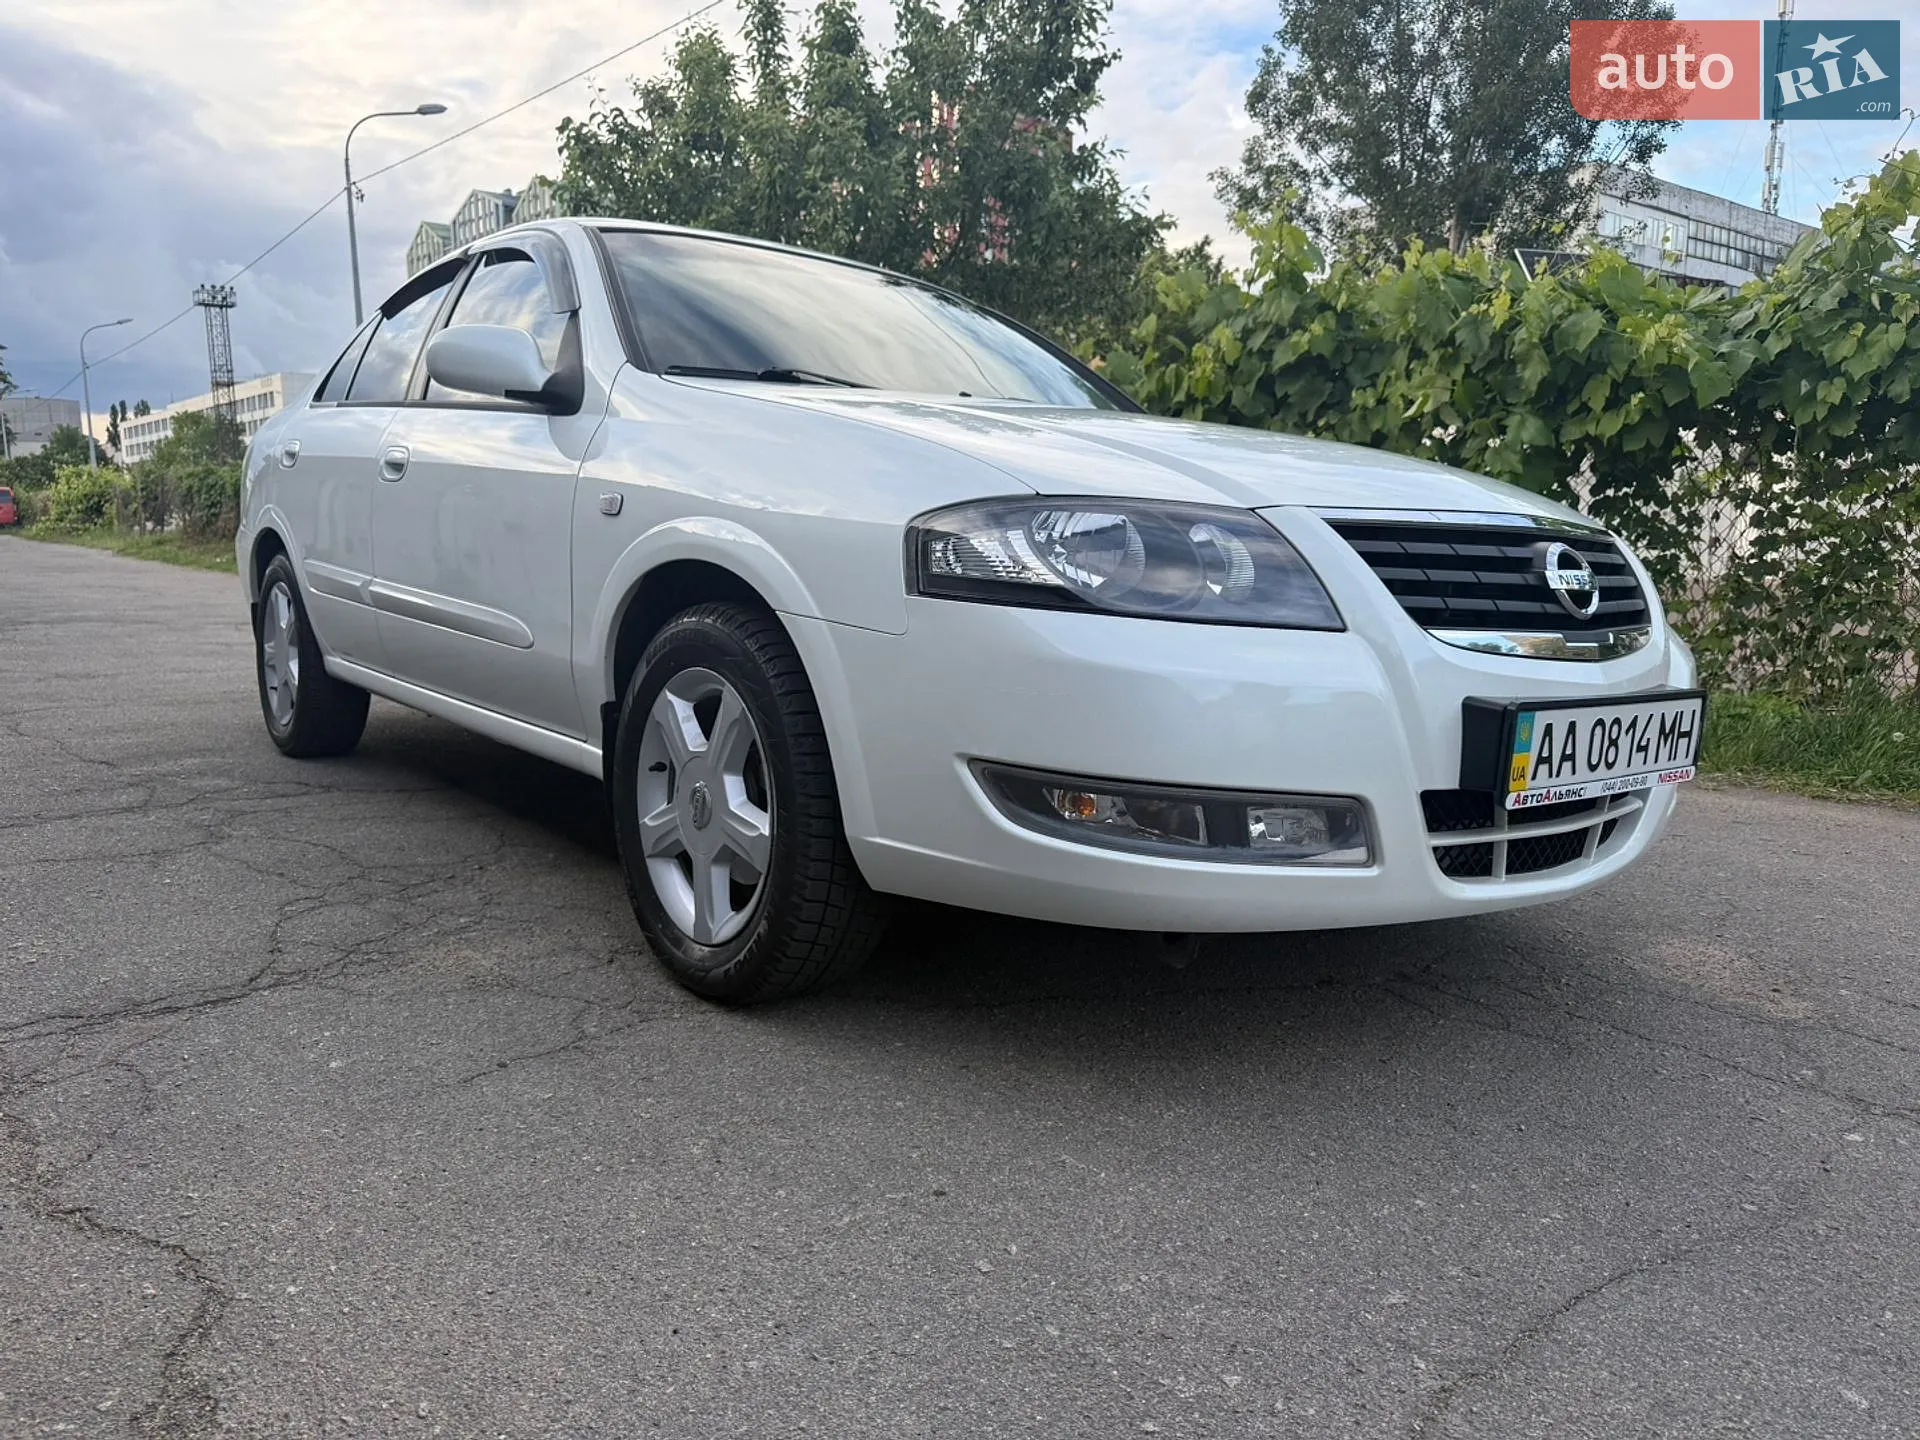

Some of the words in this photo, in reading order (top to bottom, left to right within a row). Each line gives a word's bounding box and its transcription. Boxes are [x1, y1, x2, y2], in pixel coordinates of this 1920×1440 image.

[1531, 720, 1577, 781] AA
[1586, 713, 1653, 773] 0814
[1654, 709, 1696, 764] MH
[1512, 766, 1526, 782] UA
[1657, 768, 1692, 784] NISSAN
